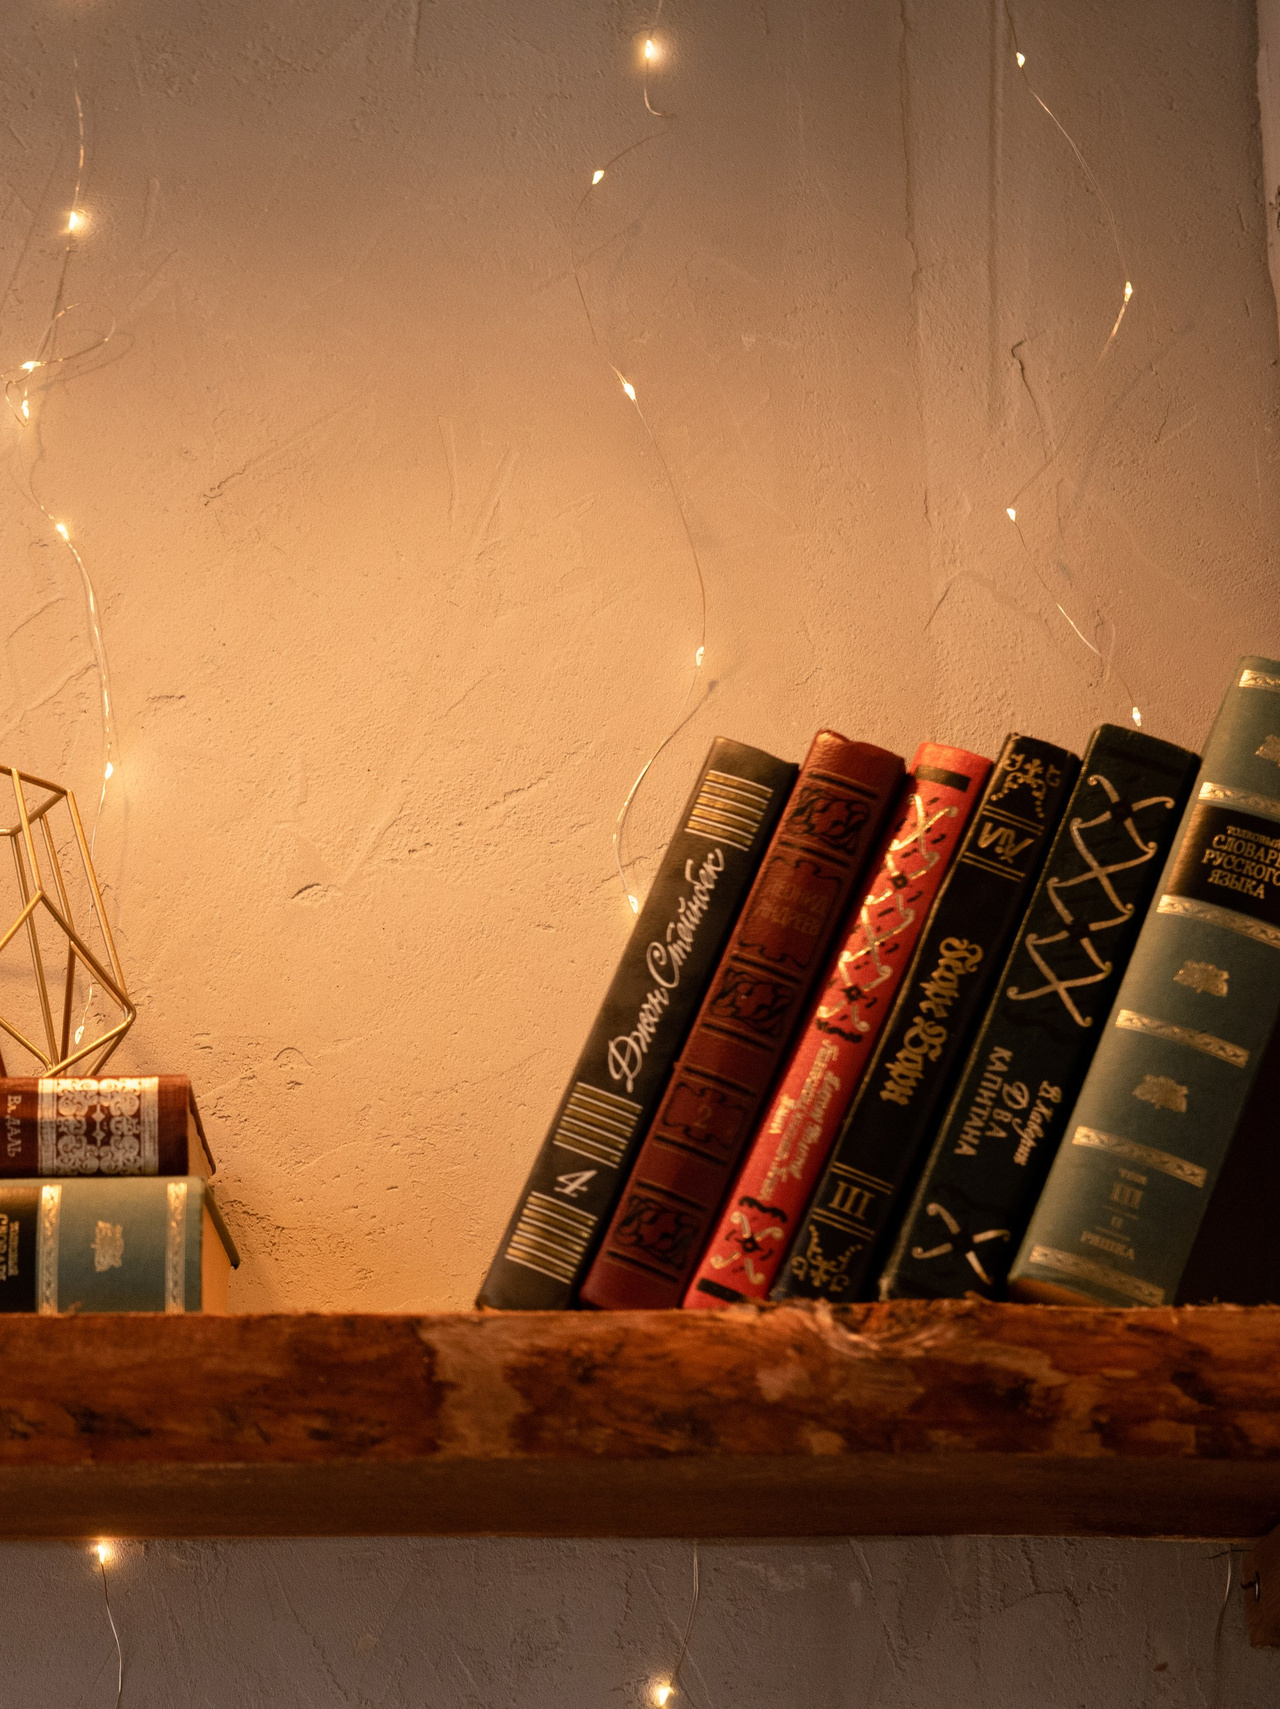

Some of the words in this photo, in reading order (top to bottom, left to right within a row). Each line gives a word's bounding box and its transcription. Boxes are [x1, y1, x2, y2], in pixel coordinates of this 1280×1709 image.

[1207, 869, 1265, 899] ЯЗЫКА
[608, 987, 670, 1094] Джон
[646, 848, 725, 988] Стейнбек
[879, 1016, 948, 1106] Борн
[693, 1104, 712, 1128] 2
[953, 1046, 1013, 1156] КАПИТАНА
[1011, 1099, 1054, 1166] Каверин
[553, 1169, 598, 1198] 4
[828, 1181, 875, 1219] III
